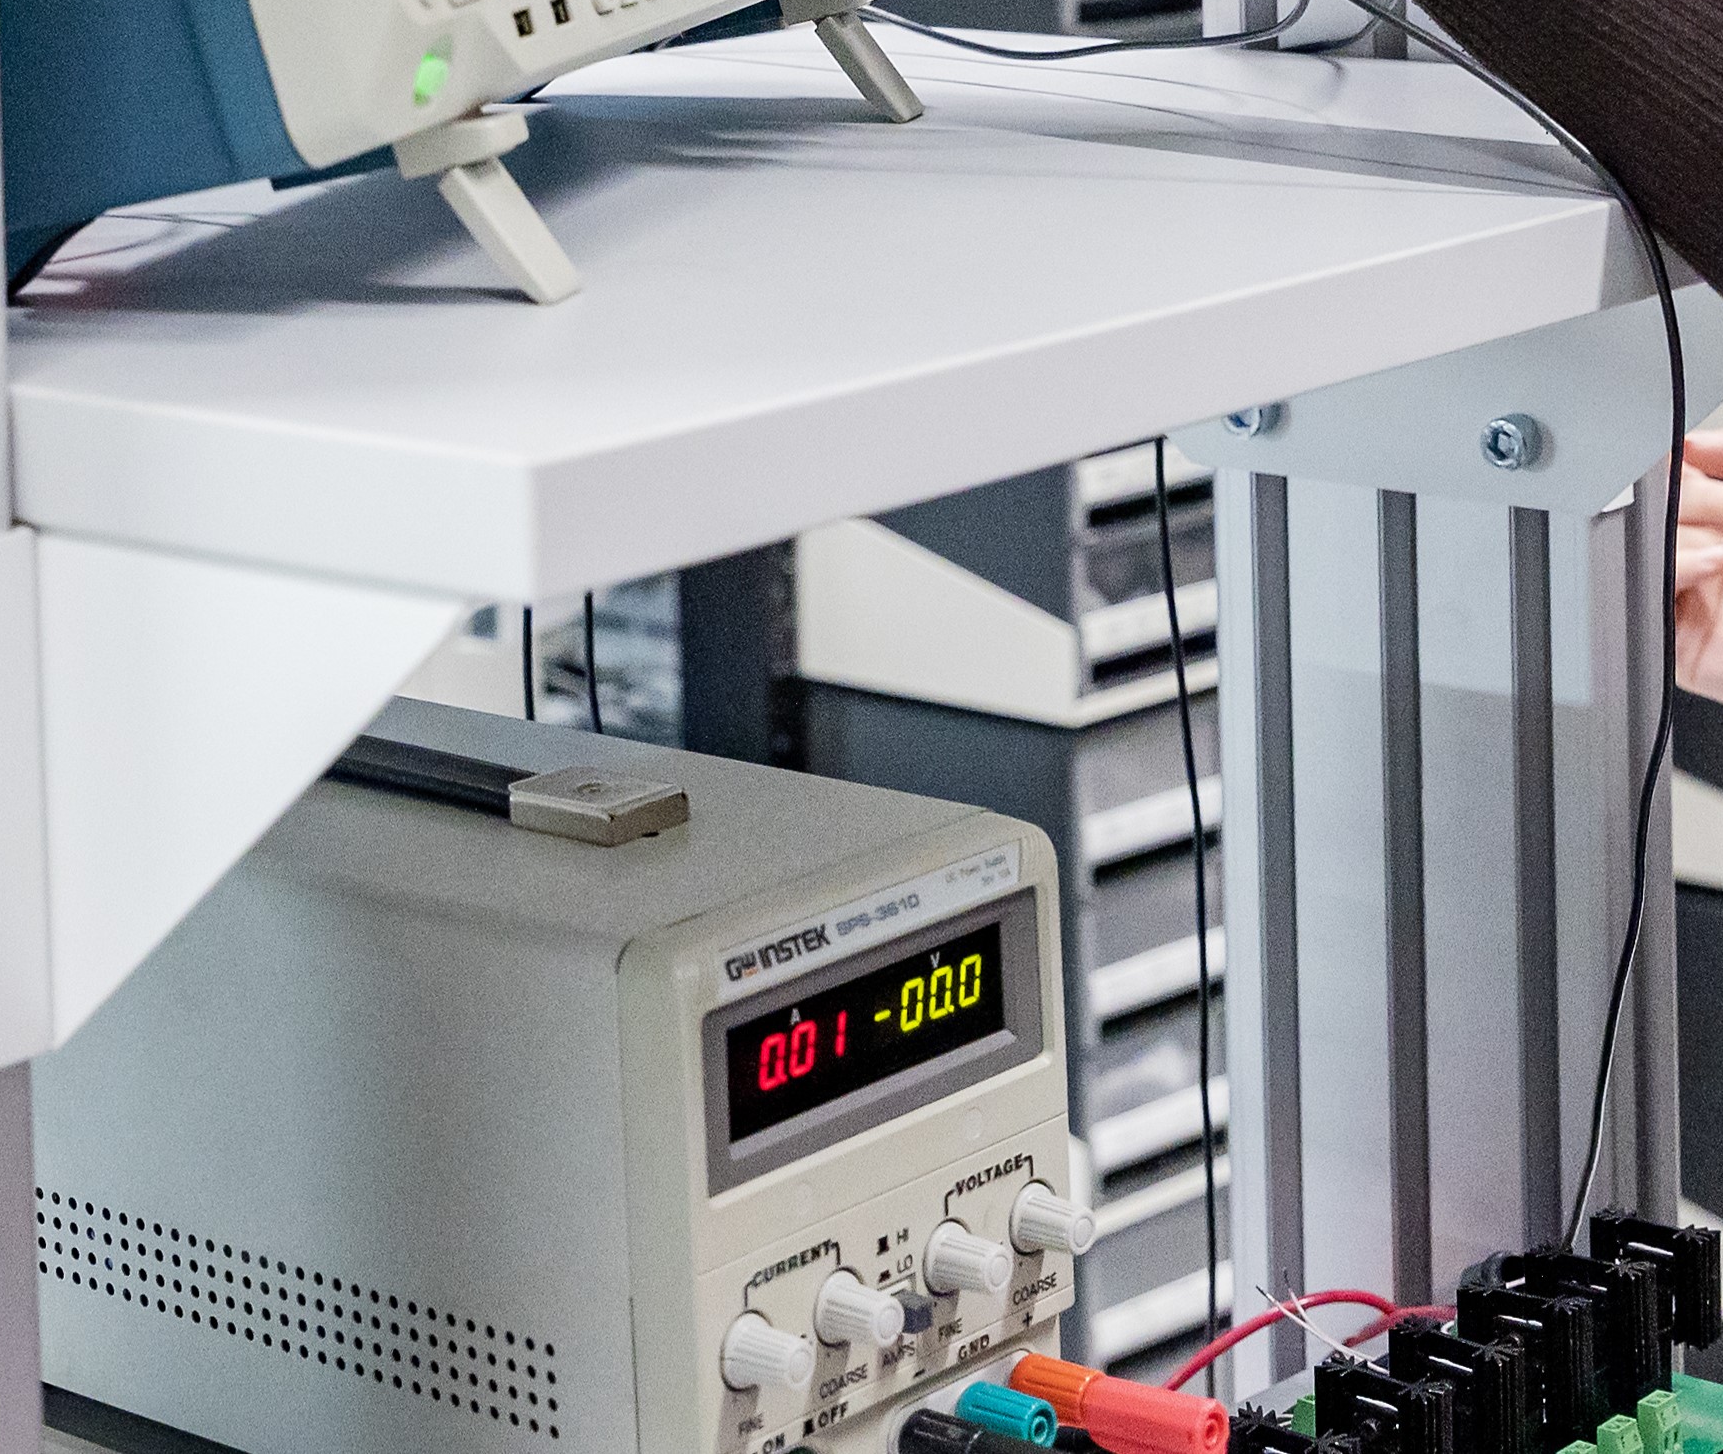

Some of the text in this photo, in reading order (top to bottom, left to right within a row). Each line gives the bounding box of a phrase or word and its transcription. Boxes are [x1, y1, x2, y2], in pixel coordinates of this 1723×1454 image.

[954, 1153, 1025, 1197] VOLTAGE
[896, 1228, 910, 1245] HI
[752, 1238, 832, 1288] CURRENT
[896, 1254, 914, 1274] LO
[1012, 1272, 1058, 1306] COARSE
[958, 1334, 990, 1361] GND
[818, 1362, 868, 1399] COARSE
[762, 1400, 849, 1454] ON OFF
